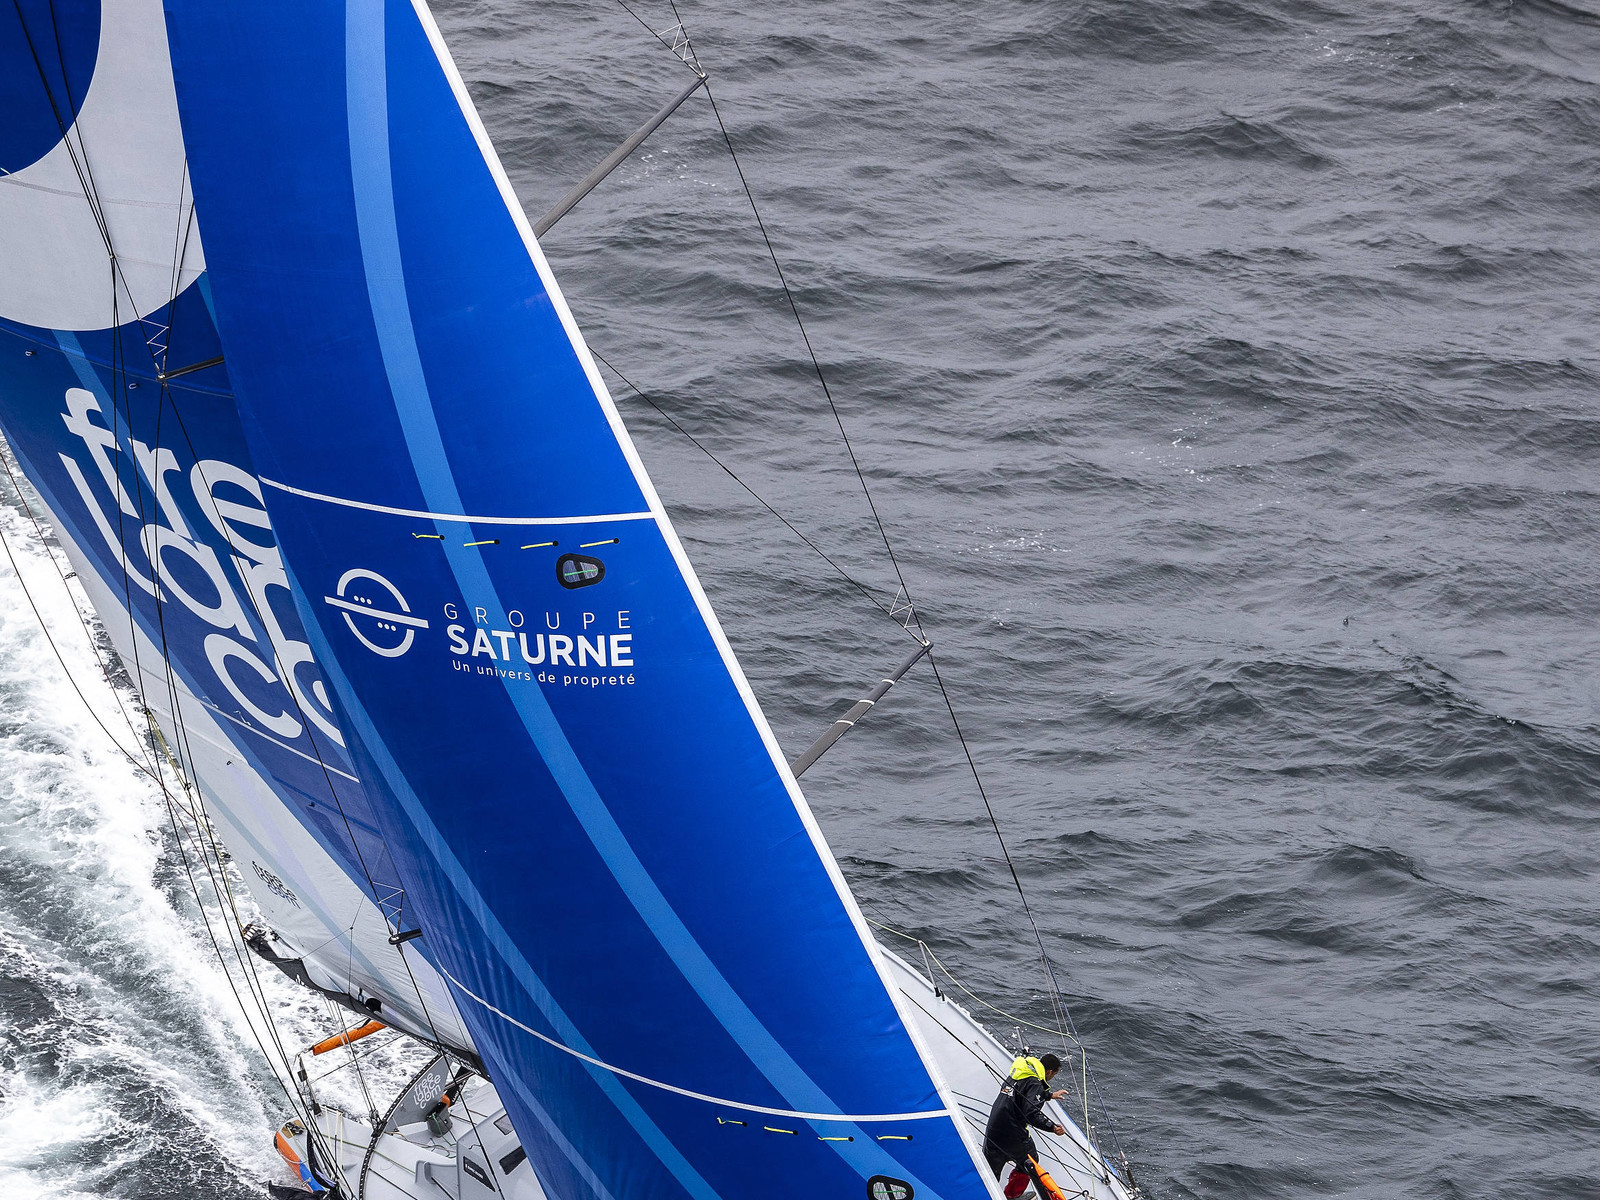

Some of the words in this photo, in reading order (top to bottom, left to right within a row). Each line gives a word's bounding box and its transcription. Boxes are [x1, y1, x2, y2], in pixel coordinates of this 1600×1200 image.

[444, 603, 631, 630] GROUPE
[446, 624, 634, 667] SATURNE
[452, 659, 470, 673] Un
[476, 665, 531, 681] univers
[538, 671, 556, 684] de
[563, 673, 635, 688] propreté
